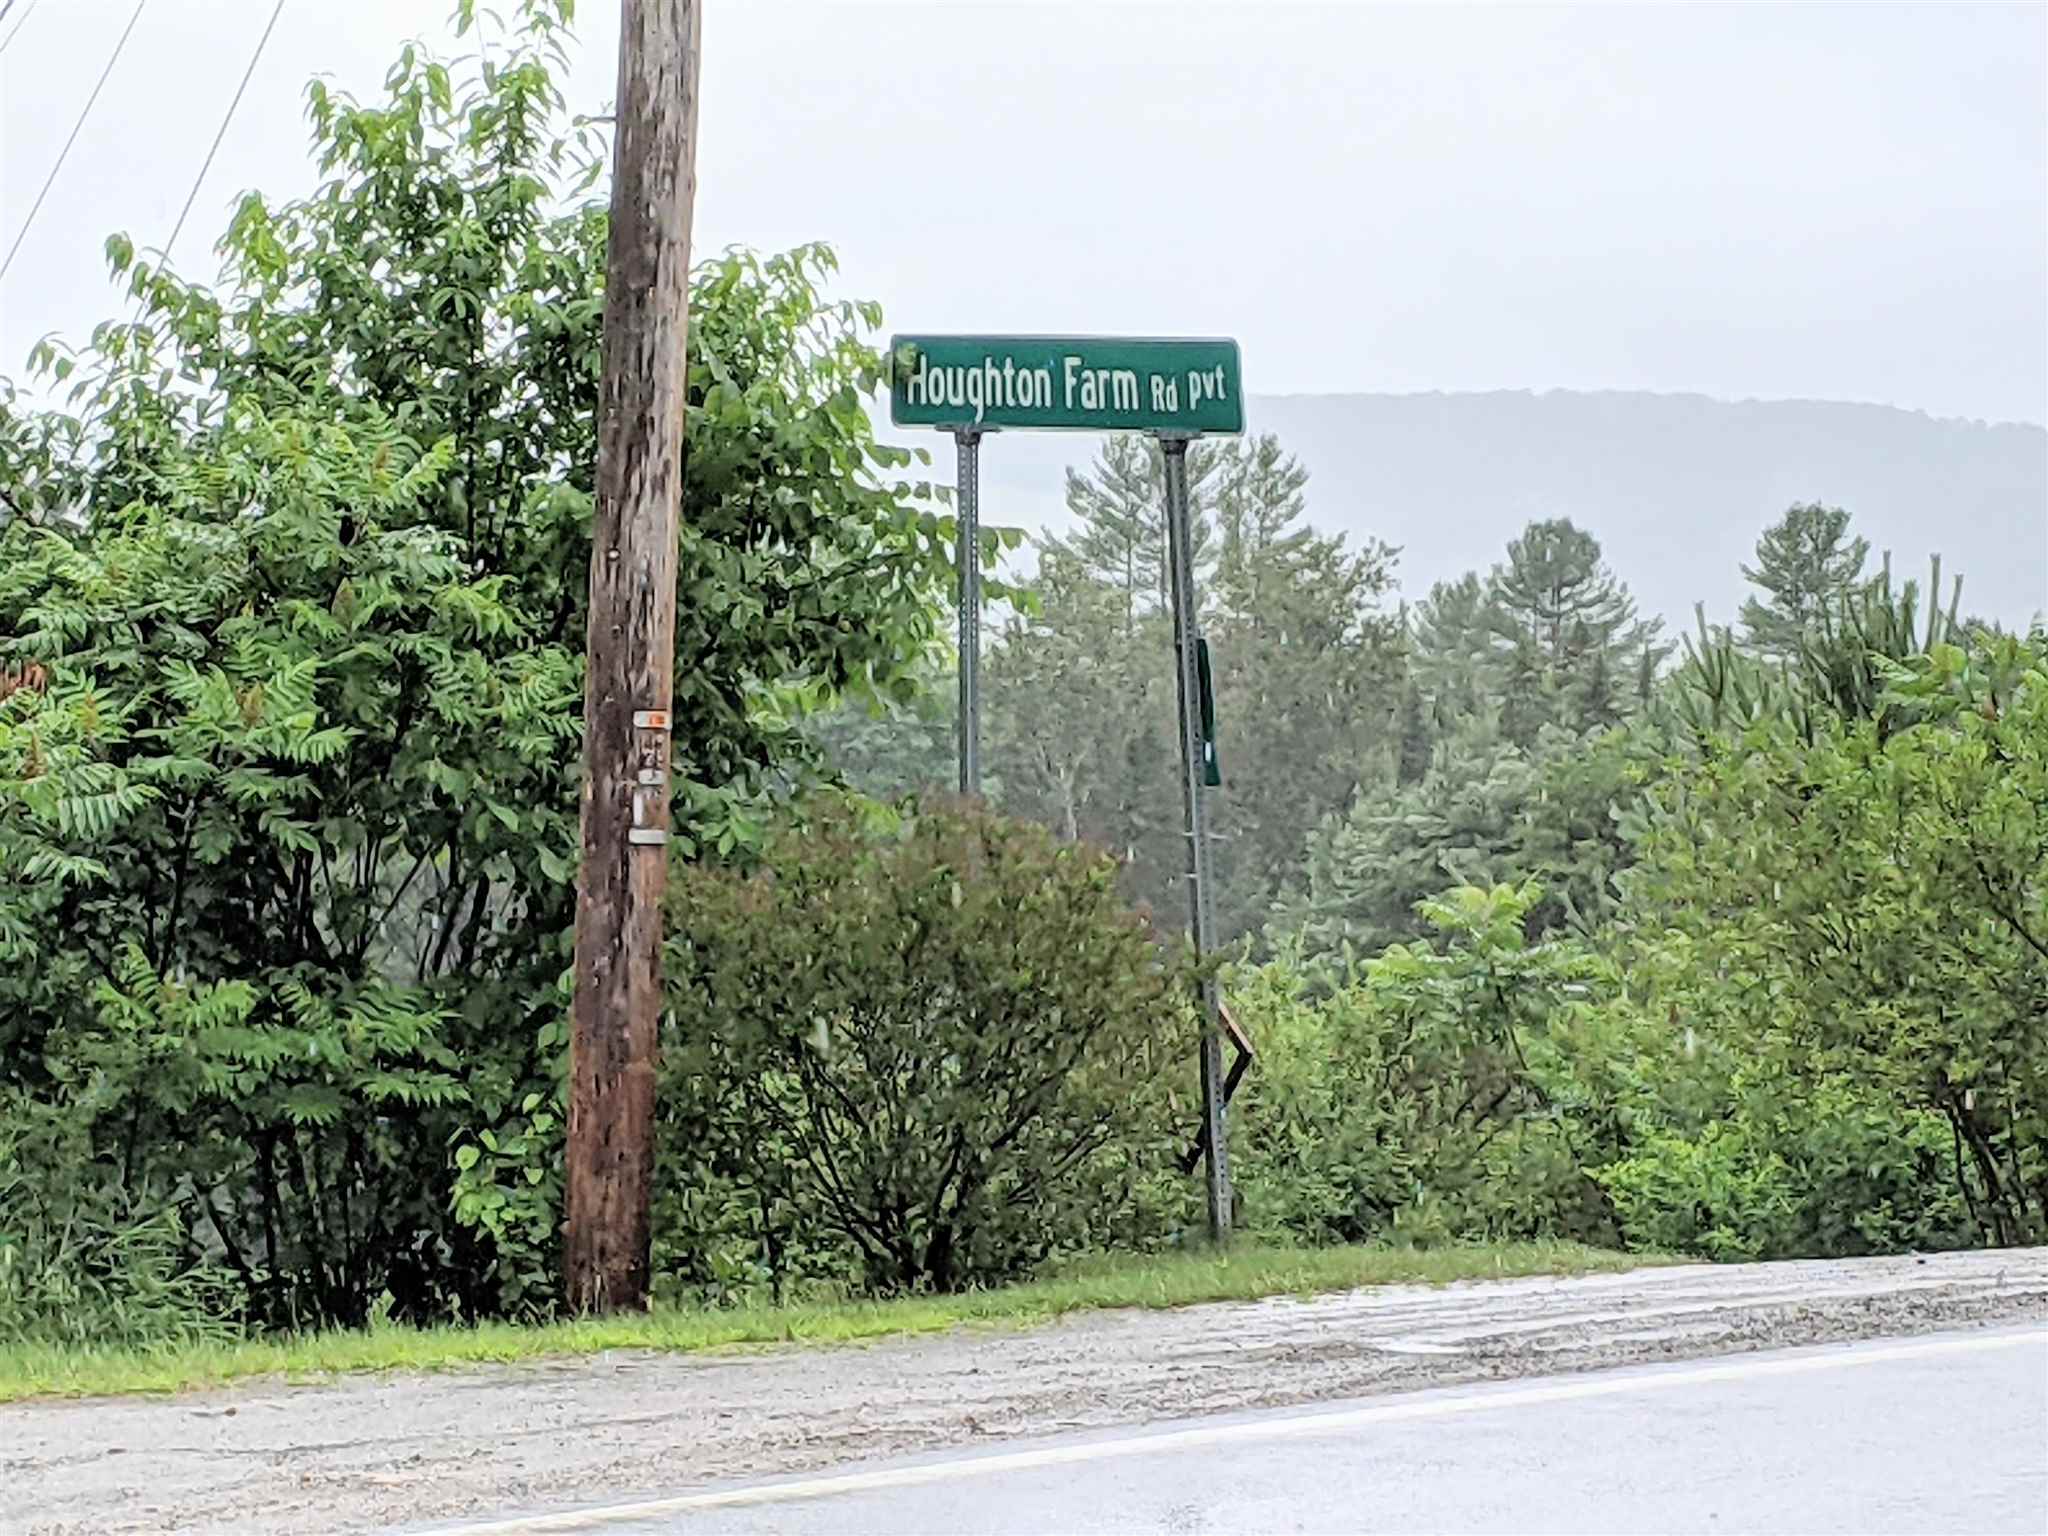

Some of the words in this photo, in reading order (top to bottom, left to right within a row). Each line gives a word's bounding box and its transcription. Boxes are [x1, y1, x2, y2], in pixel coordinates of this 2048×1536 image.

[1064, 356, 1139, 411] Farm
[1150, 374, 1178, 412] Rd
[1188, 365, 1226, 410] pvt
